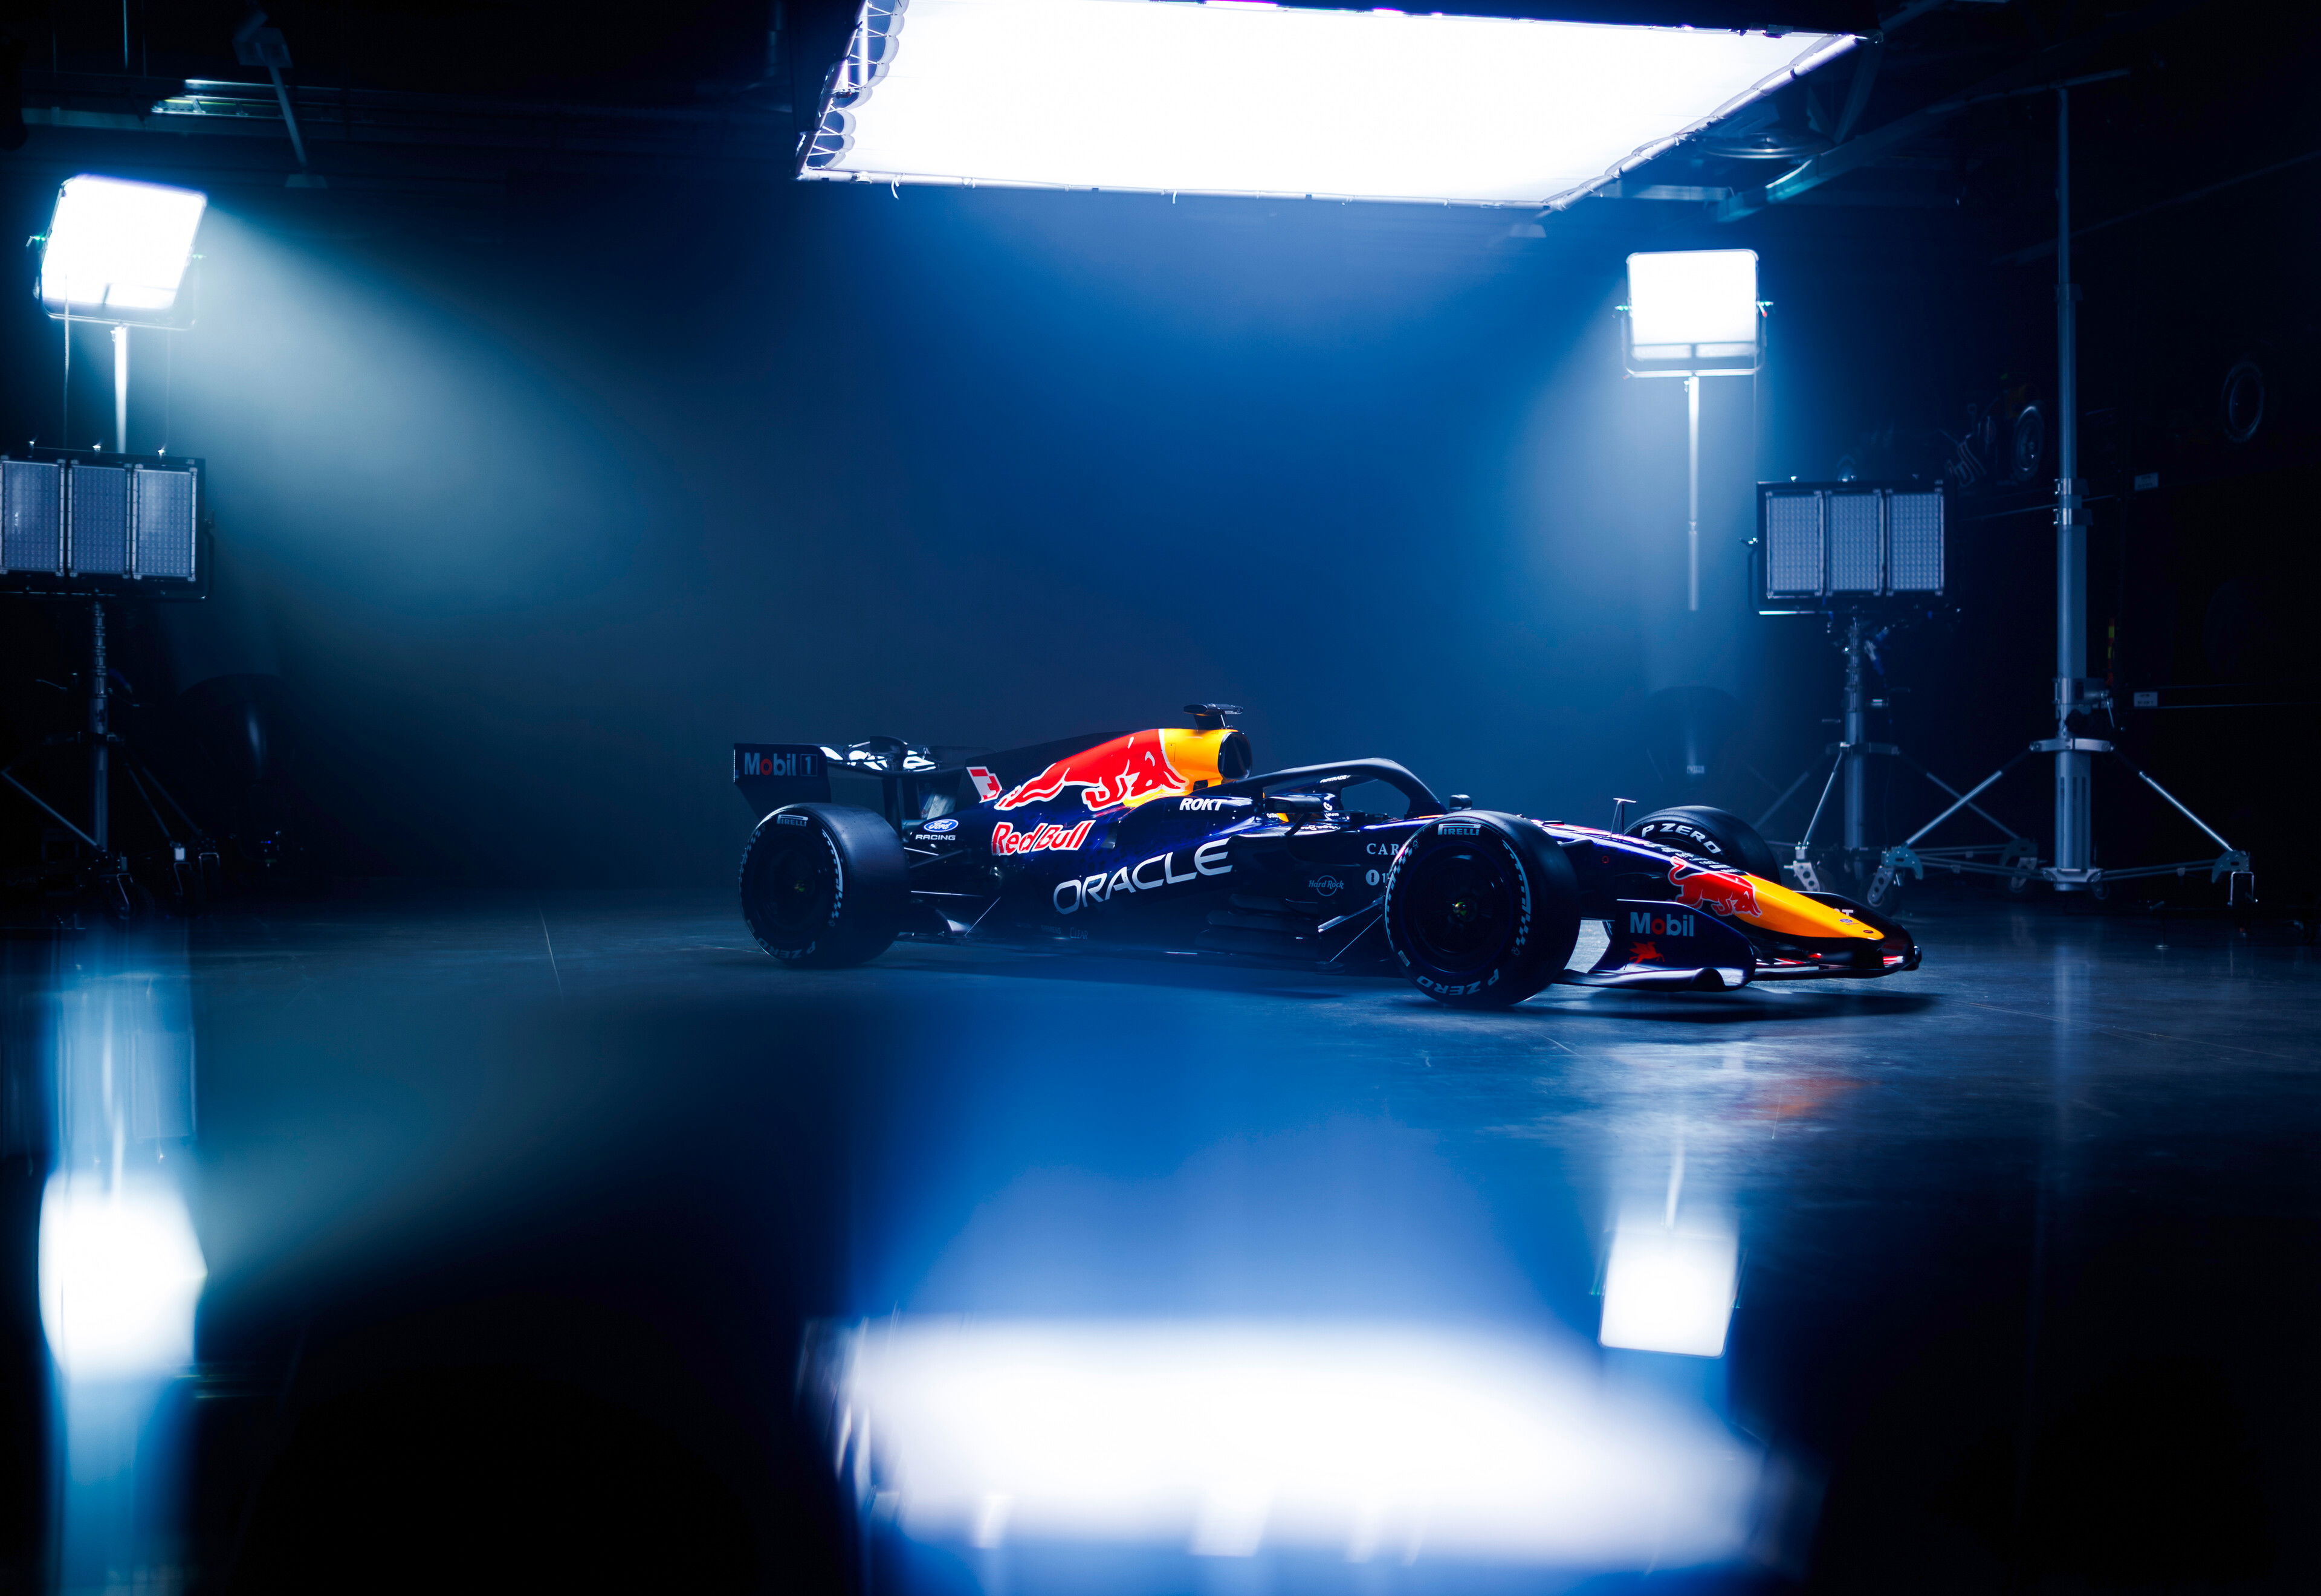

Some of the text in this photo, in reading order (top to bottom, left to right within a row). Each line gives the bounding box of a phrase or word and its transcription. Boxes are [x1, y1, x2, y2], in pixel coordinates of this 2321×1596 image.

[744, 752, 812, 777] Mobil 1
[1179, 798, 1225, 811] ROKT
[776, 814, 809, 827] PIRELLI
[928, 821, 951, 830] Ford
[1437, 824, 1481, 836] PIRELLI
[1642, 823, 1721, 854] P ZERO
[1054, 838, 1233, 915] ORACLE
[1308, 879, 1345, 890] Hard Rock
[1630, 911, 1694, 937] Mobil
[1416, 968, 1500, 996] P ZERO
